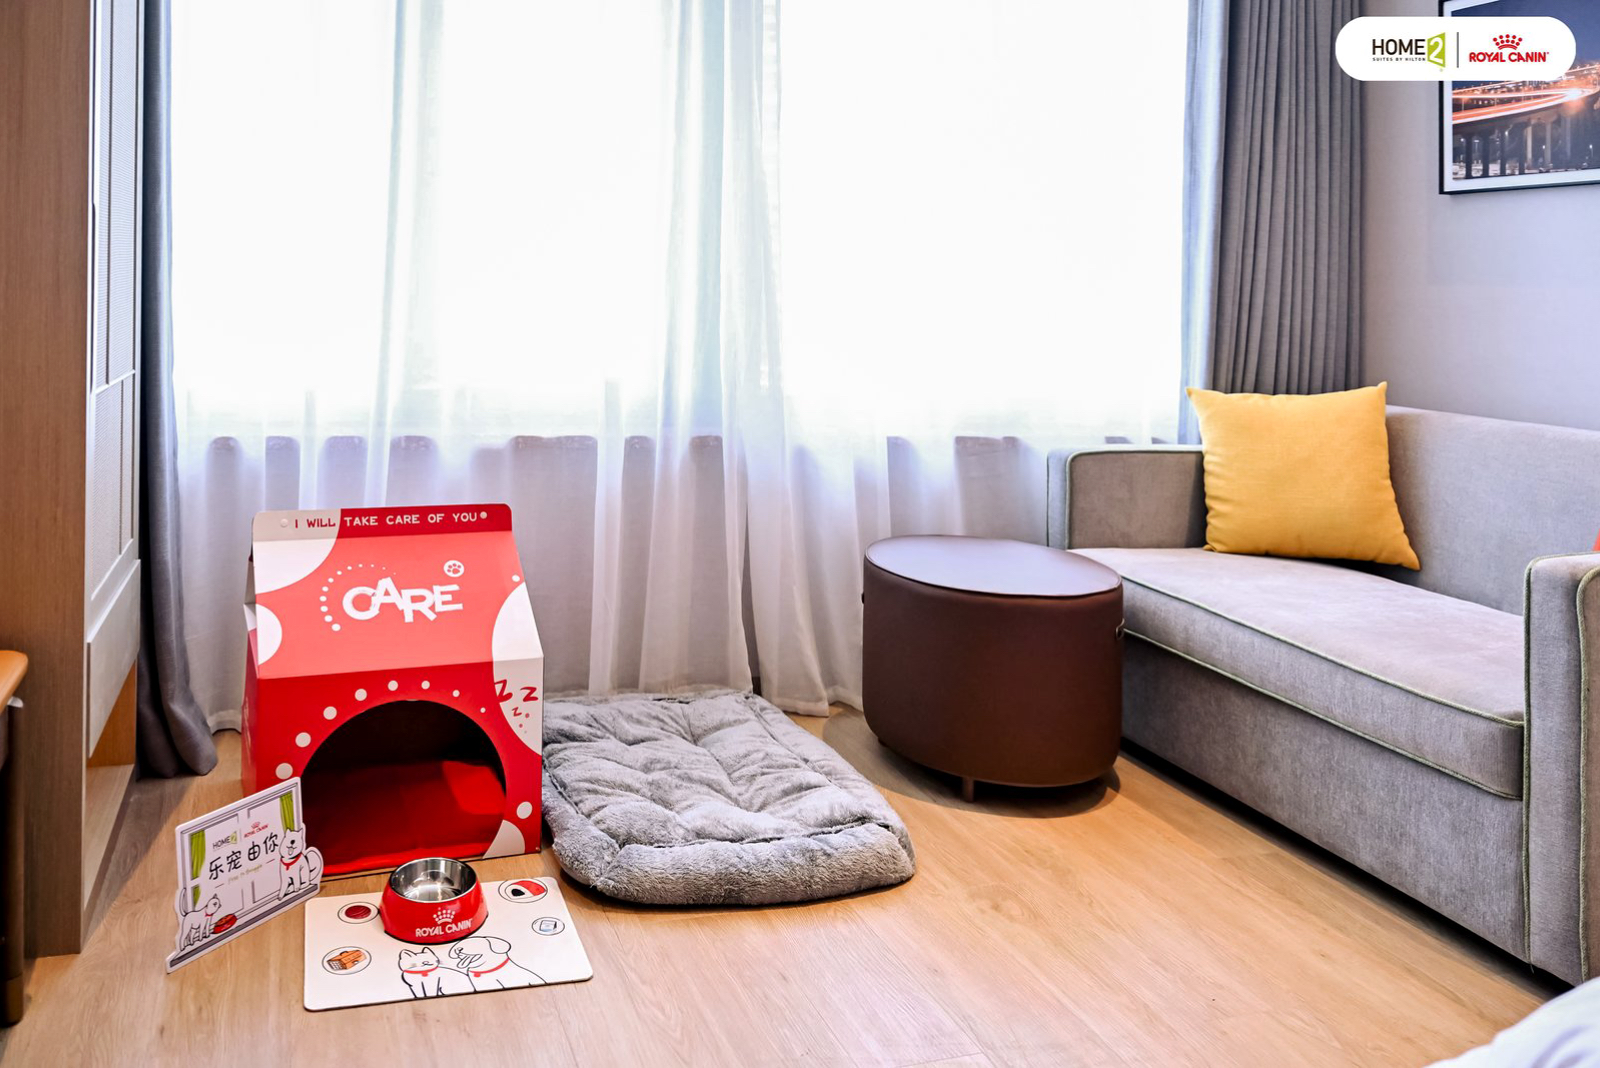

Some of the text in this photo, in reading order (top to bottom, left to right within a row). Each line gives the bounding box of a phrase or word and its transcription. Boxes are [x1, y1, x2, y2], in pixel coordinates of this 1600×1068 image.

[307, 518, 336, 528] WILL
[344, 516, 378, 527] TAKE
[386, 514, 420, 525] CARE
[427, 513, 445, 524] OF
[452, 512, 478, 523] YOU
[342, 576, 463, 623] CARE
[209, 832, 279, 880] 乐宠由你
[415, 920, 472, 938] ROYAL CANIN
